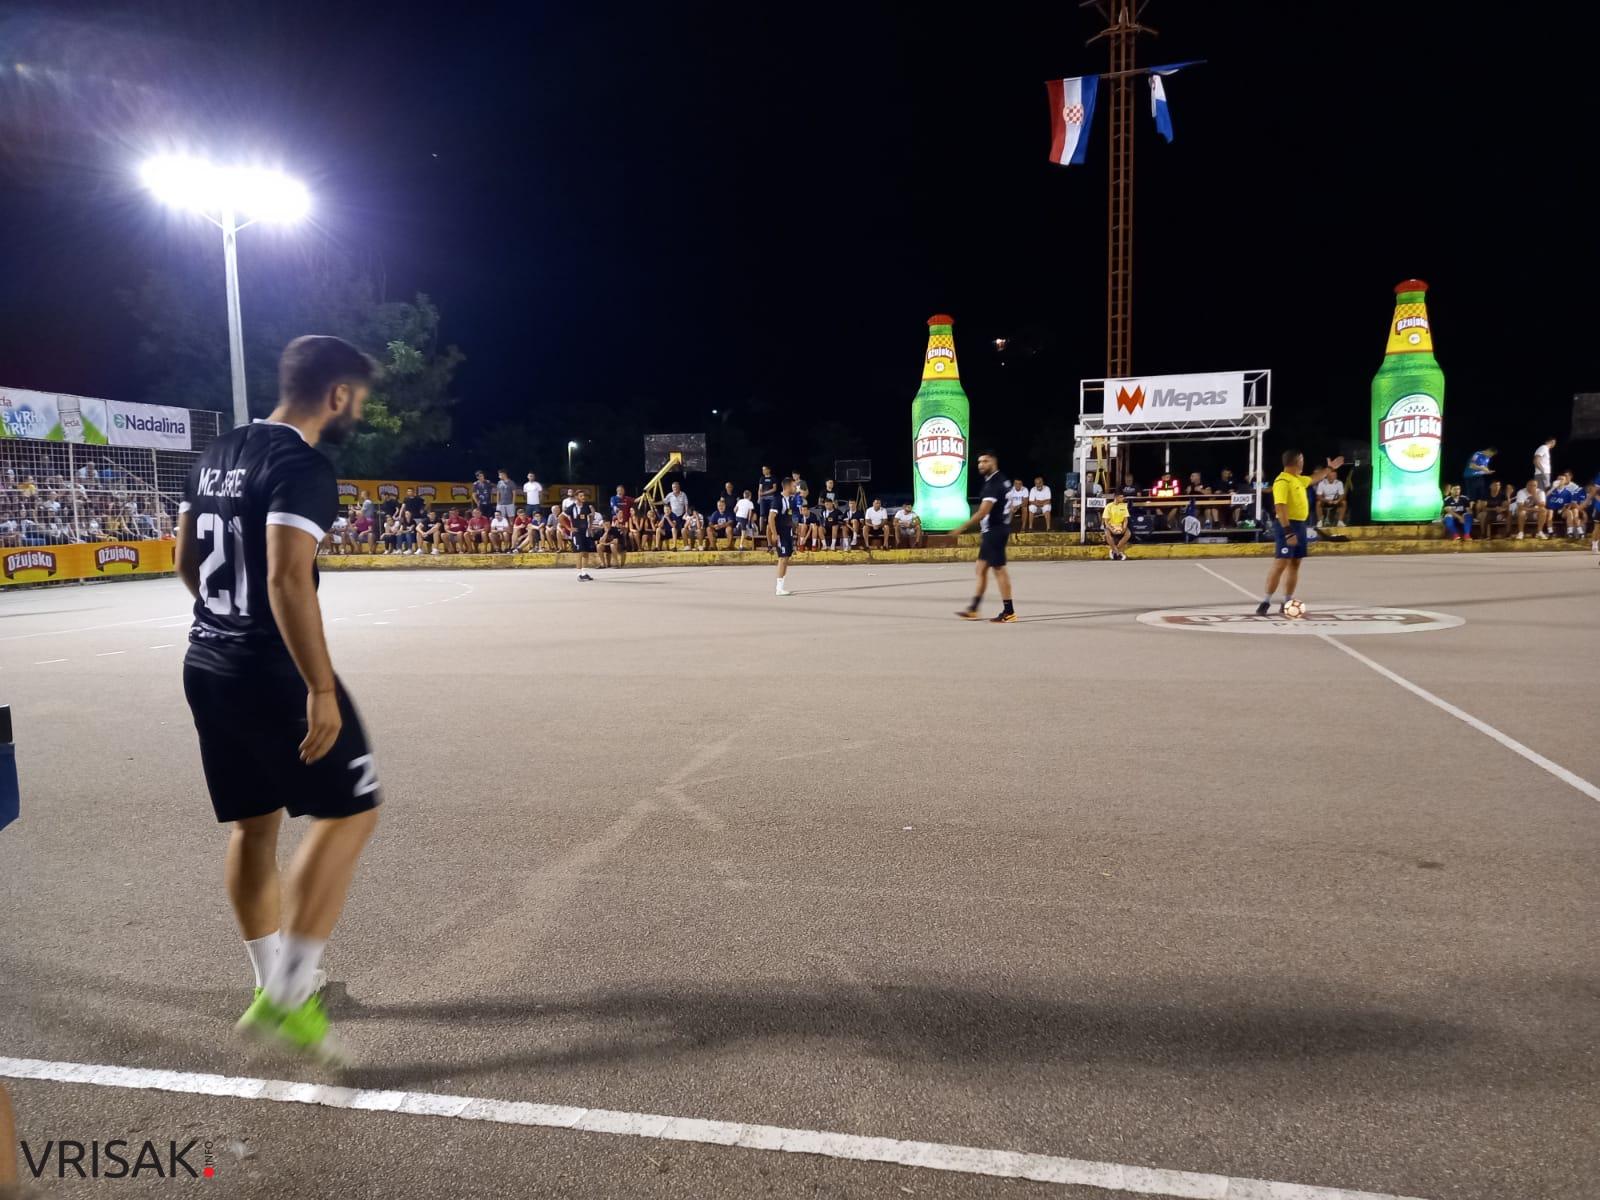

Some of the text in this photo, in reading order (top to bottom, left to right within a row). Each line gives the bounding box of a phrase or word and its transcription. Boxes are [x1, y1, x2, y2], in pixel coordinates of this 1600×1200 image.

[1152, 389, 1228, 411] Mepas
[125, 414, 185, 434] Nadalina
[8, 551, 52, 571] Ožujsko
[99, 546, 136, 564] Ožujsko
[197, 512, 249, 617] 21
